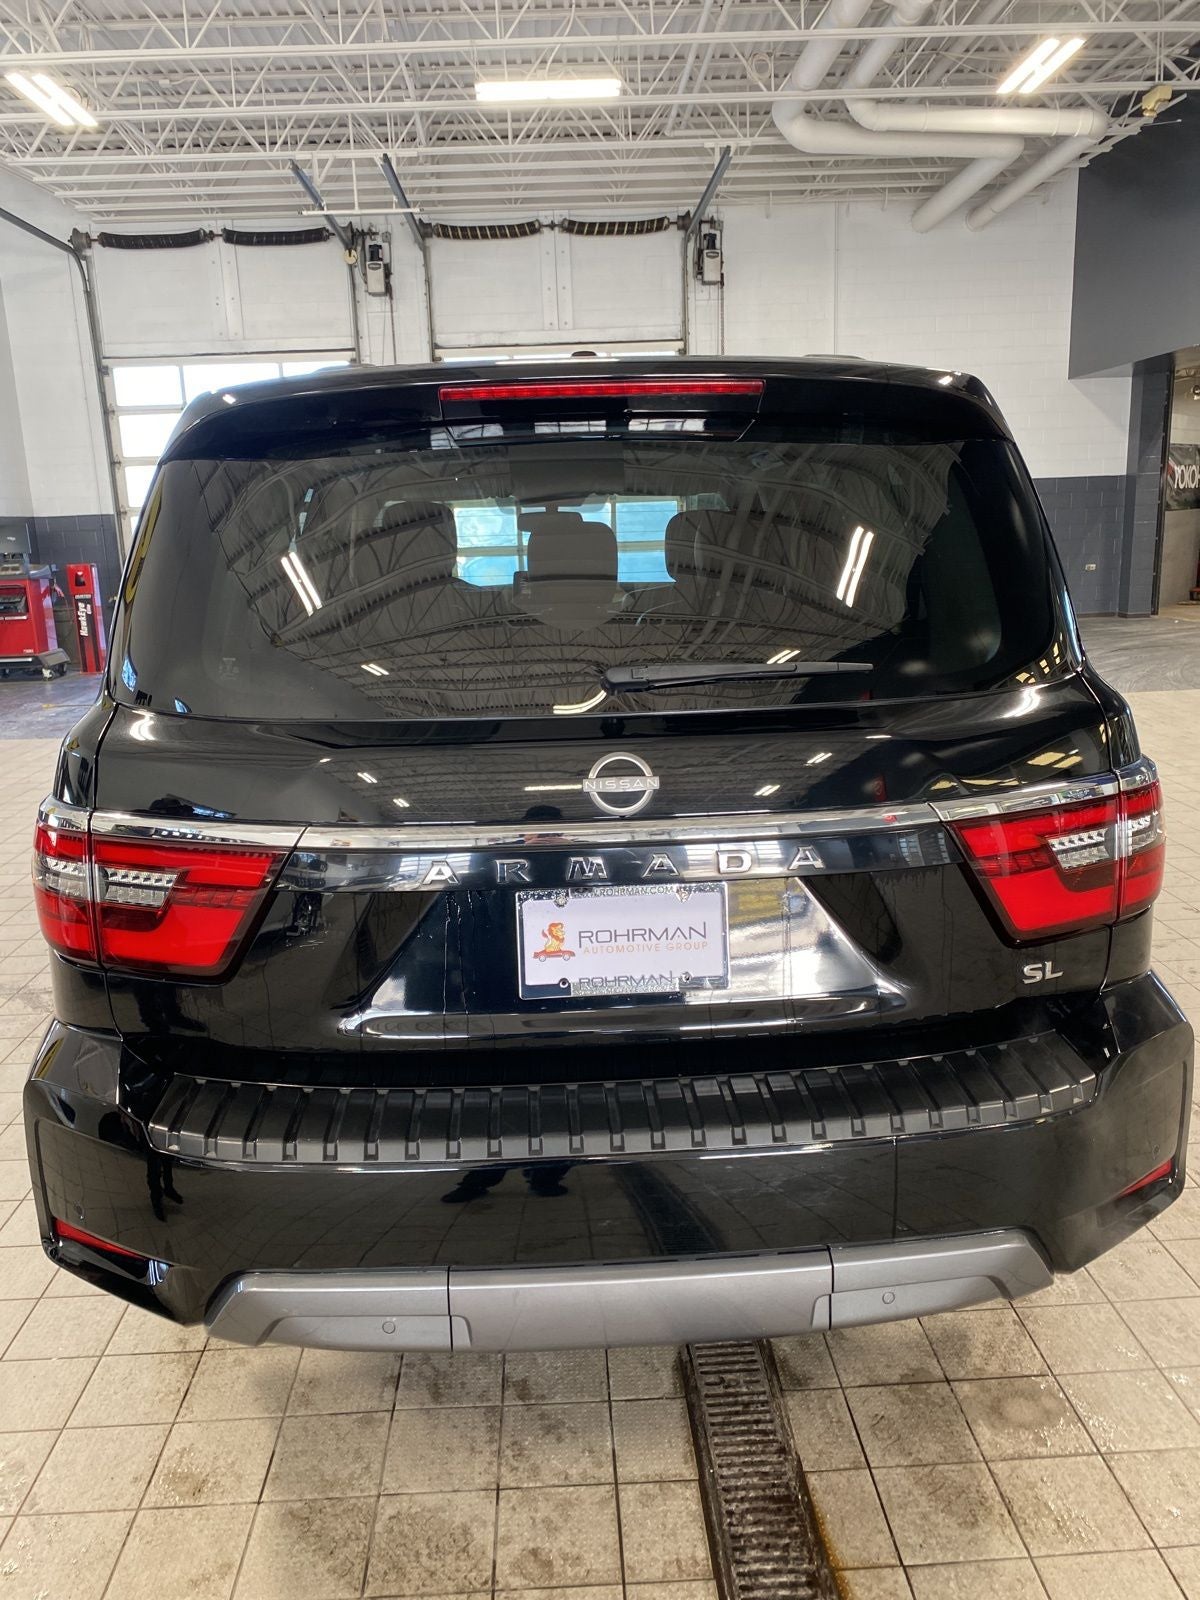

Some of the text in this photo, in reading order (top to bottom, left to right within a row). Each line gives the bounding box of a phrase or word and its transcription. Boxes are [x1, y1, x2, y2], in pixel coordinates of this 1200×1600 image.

[585, 778, 658, 790] NISSAN
[422, 846, 826, 886] ARMADA
[578, 921, 707, 948] ROHRMAN
[583, 941, 708, 955] AUTOMOTIVE GROUP
[578, 970, 673, 988] ROHRMAN
[1022, 961, 1064, 984] SL
